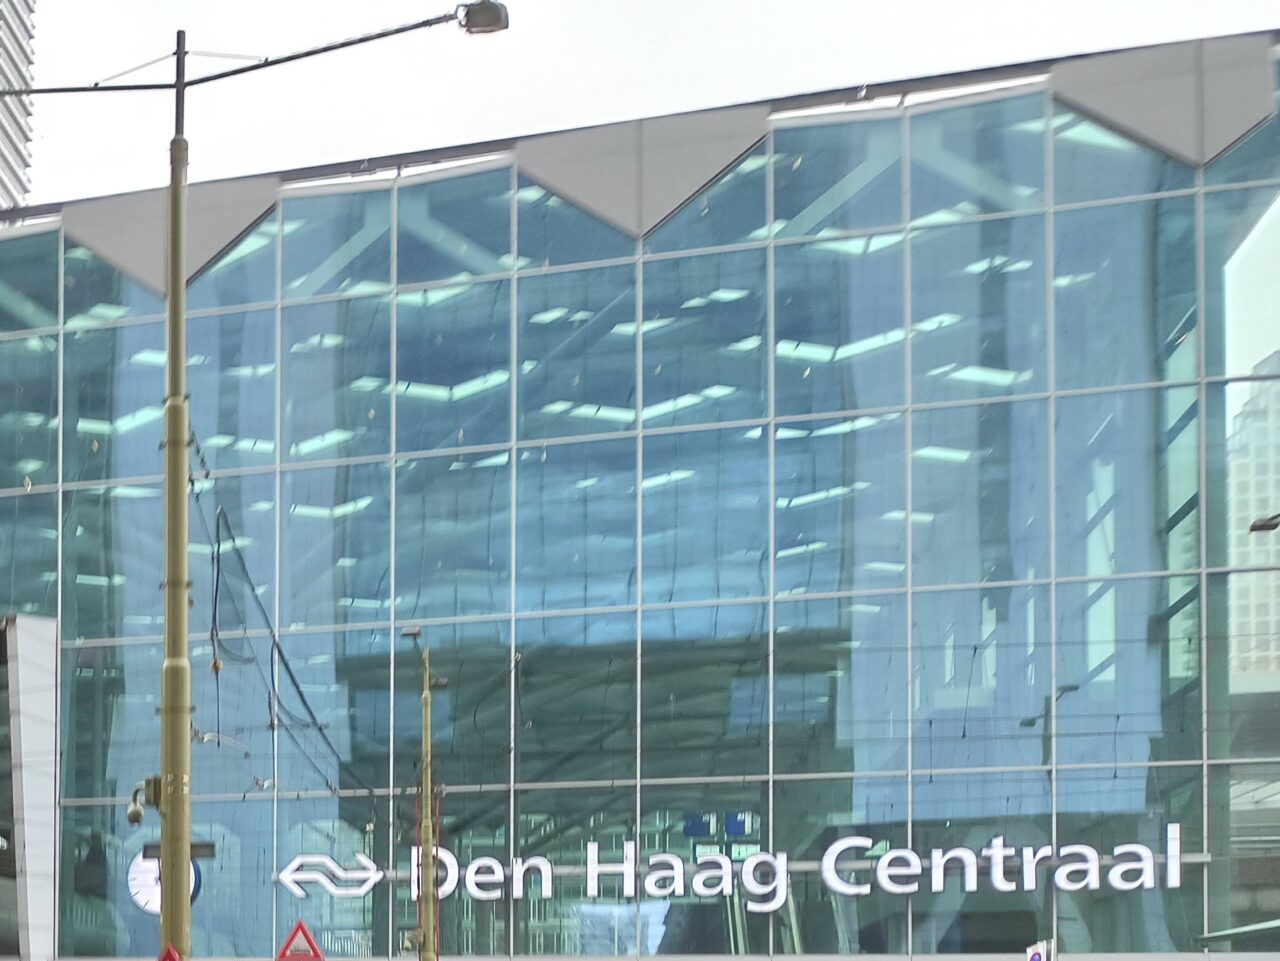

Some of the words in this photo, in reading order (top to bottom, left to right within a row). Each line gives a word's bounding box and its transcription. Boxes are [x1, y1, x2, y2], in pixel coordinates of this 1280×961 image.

[410, 845, 553, 900] Den
[586, 840, 789, 914] Haag
[821, 822, 1181, 896] Centraal
